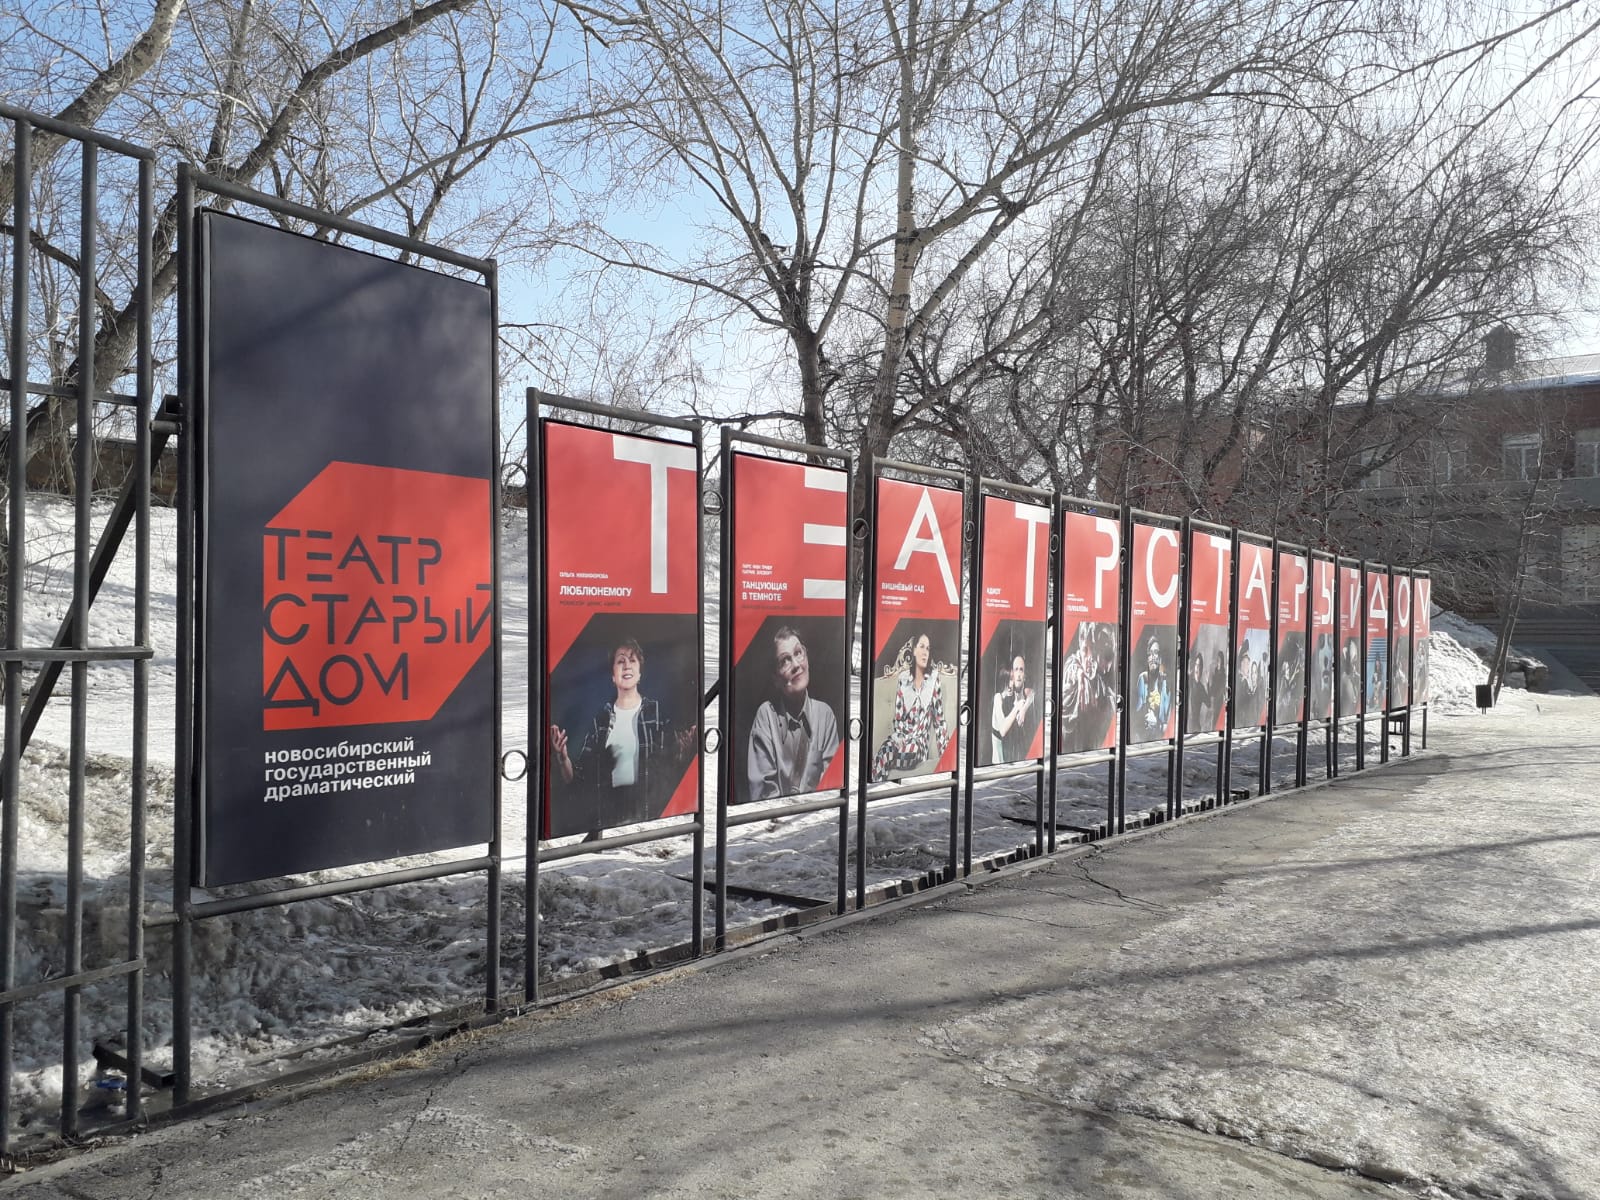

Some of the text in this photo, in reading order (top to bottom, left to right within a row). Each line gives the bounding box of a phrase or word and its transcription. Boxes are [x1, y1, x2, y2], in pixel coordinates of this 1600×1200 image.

[263, 526, 442, 586] ТЕАТР
[559, 585, 632, 597] ЛЮБЛЮНЕМОГУ
[742, 581, 788, 591] ТАНЦУЮЩАЯ
[742, 592, 782, 602] В ТЕМНОТЕ
[263, 583, 491, 645] СТАРЫЙ
[263, 652, 409, 716] ДОМ
[264, 737, 414, 766] новосибирский
[264, 752, 432, 781] государственный
[264, 769, 415, 802] драматический
